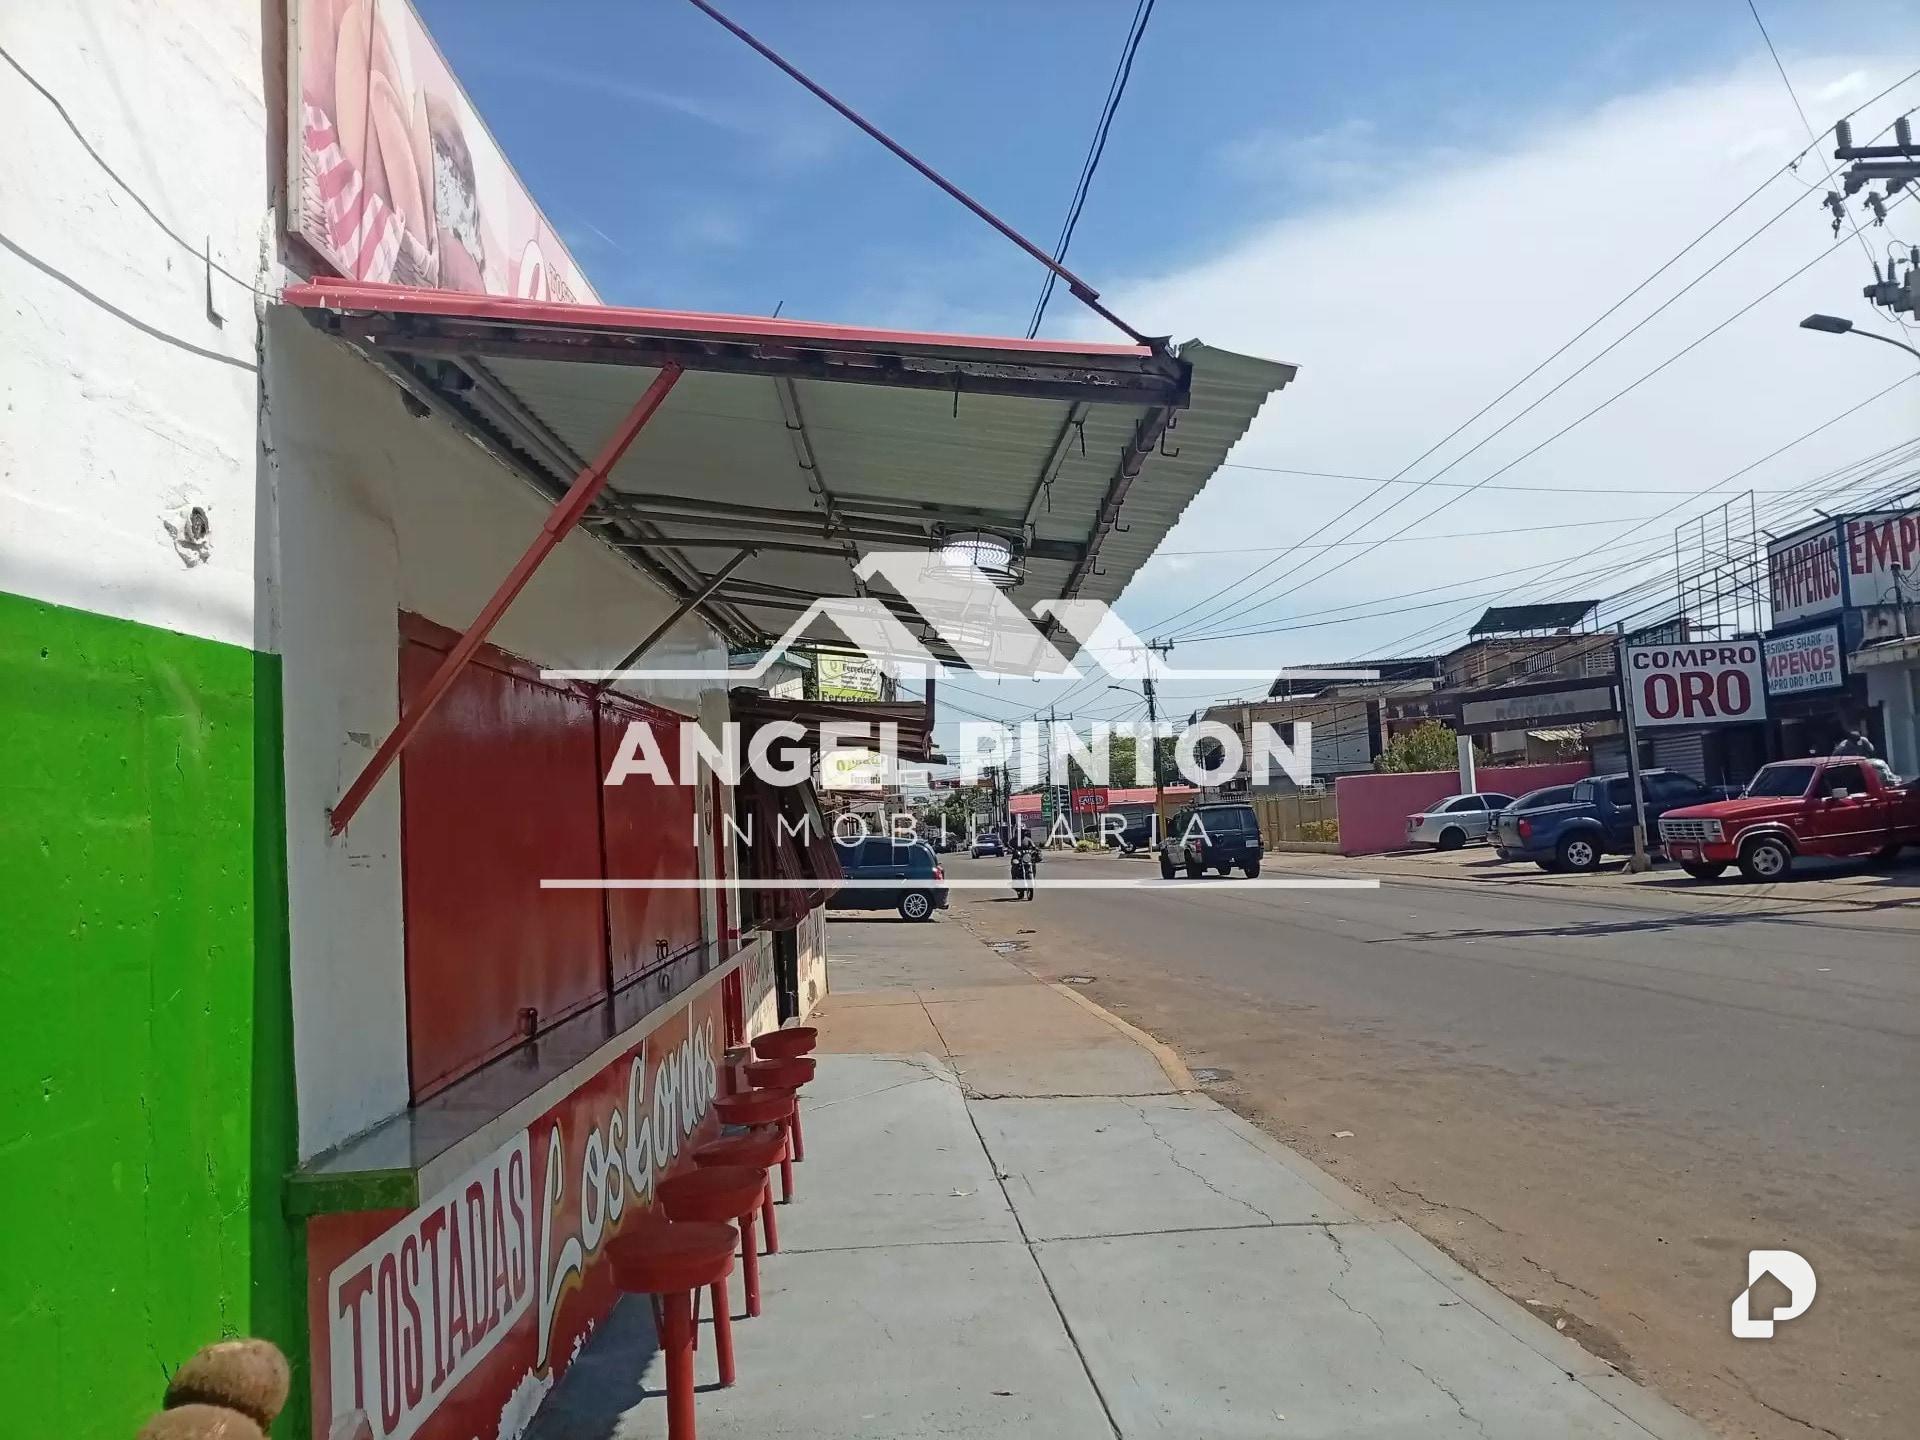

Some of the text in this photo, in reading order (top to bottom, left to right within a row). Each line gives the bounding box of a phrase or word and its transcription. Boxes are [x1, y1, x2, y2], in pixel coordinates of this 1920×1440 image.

[1846, 516, 1920, 575] EMP
[1633, 647, 1756, 670] COMPRO
[1810, 671, 1833, 684] PLATA
[1643, 669, 1751, 720] ORO
[338, 1148, 529, 1436] TOSTADAS
